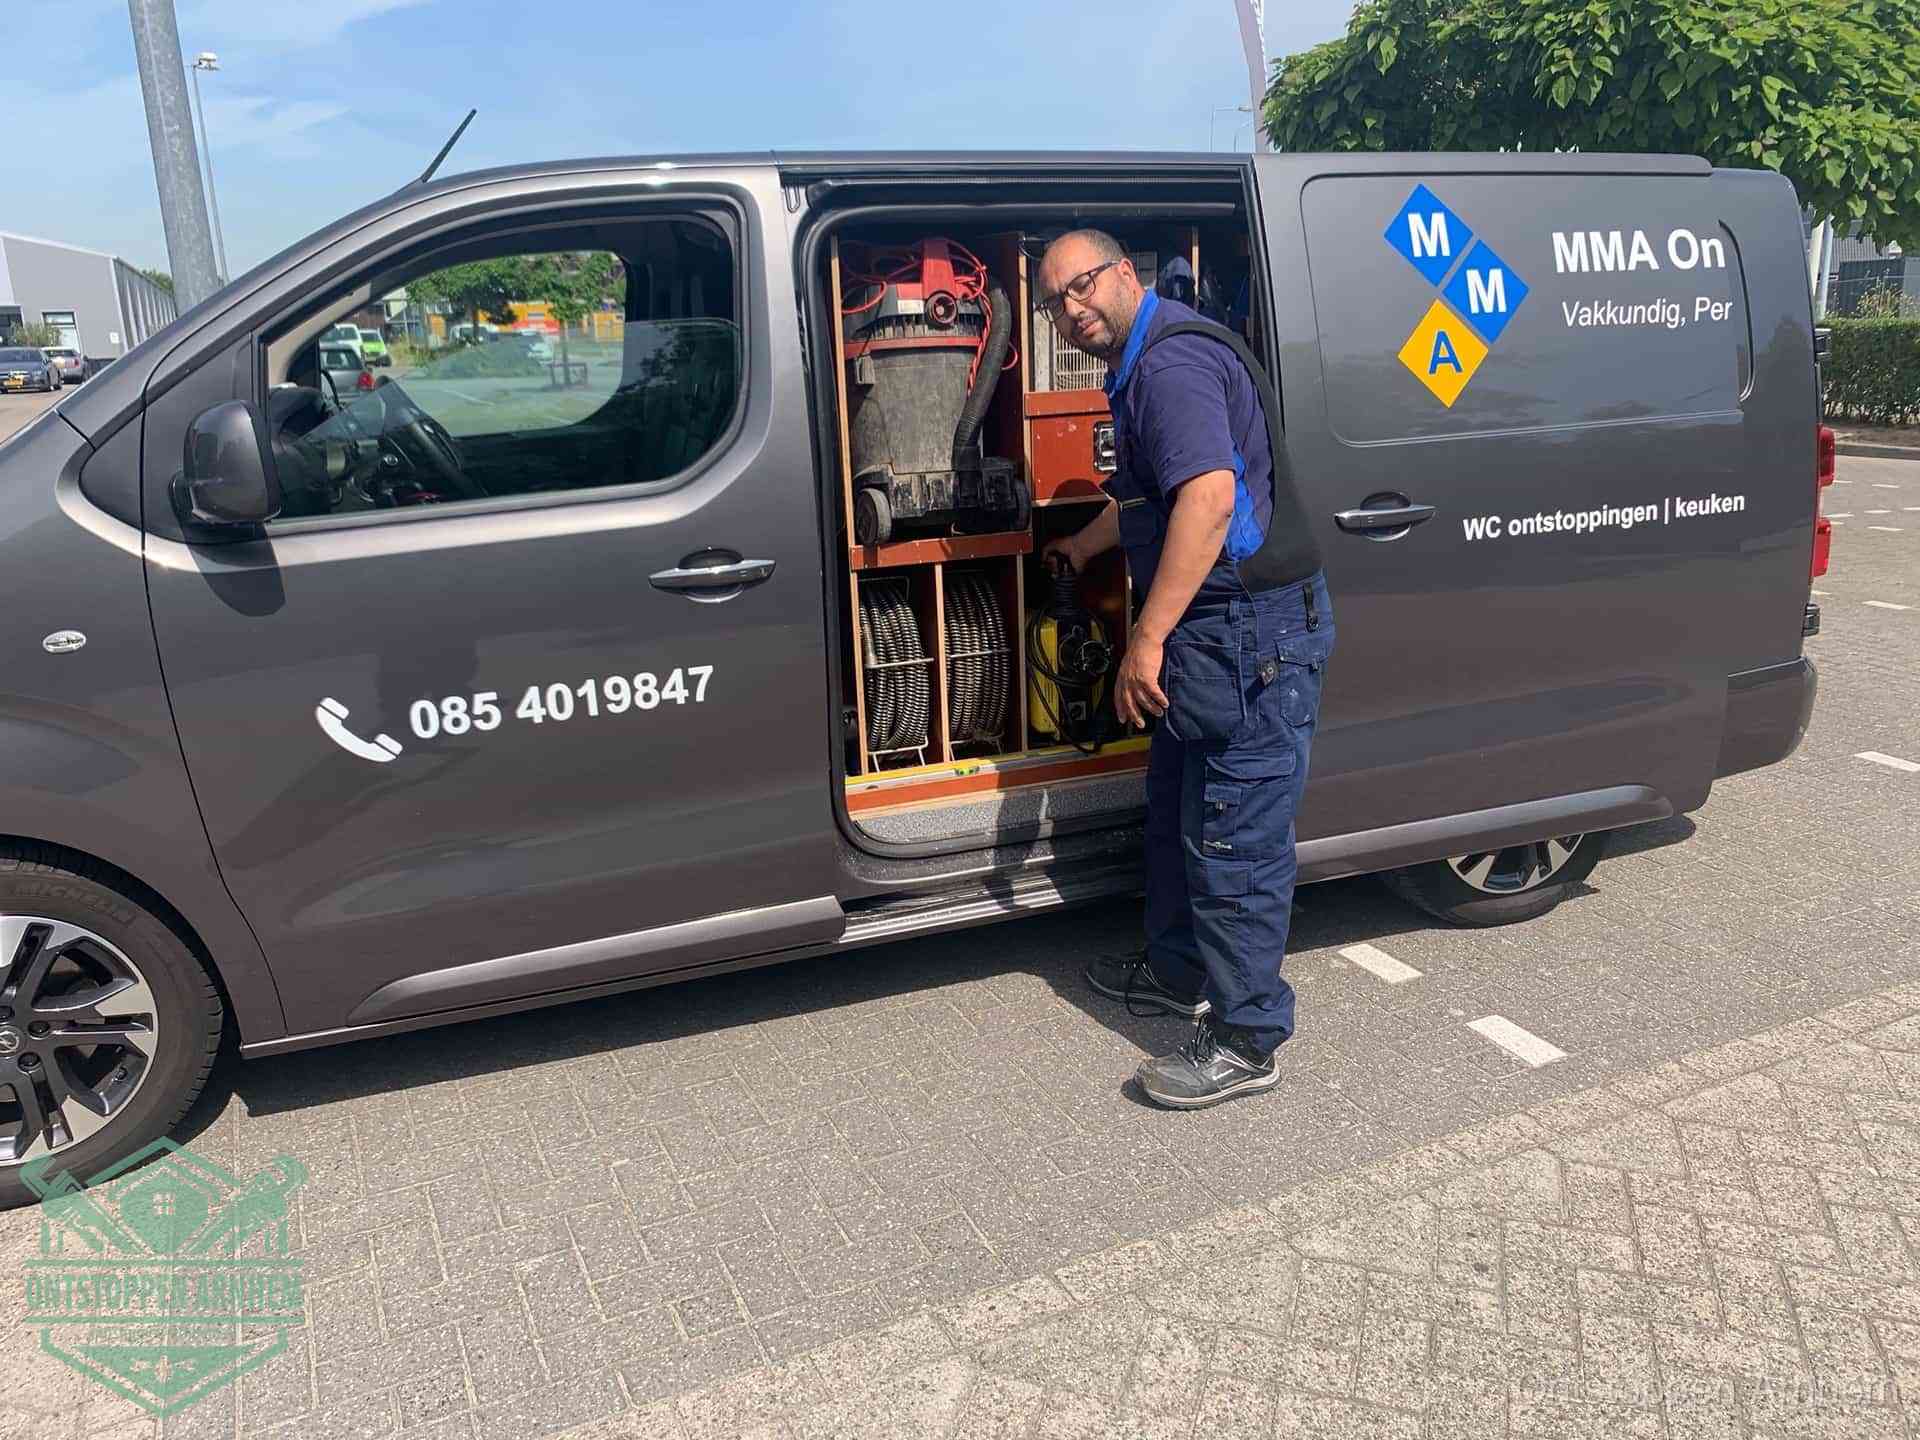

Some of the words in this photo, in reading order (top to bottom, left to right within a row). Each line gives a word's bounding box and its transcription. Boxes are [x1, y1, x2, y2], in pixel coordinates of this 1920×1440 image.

[1407, 212, 1450, 257] M
[1552, 230, 1659, 273] MMA
[1667, 229, 1725, 270] On
[1466, 268, 1507, 314] M
[1562, 299, 1688, 329] Vakkundig,
[1694, 297, 1733, 322] Per
[1428, 330, 1463, 374] A
[1463, 516, 1501, 540] WC
[1508, 504, 1659, 533] ontstoppingen
[1675, 493, 1746, 518] keuken
[409, 692, 501, 739] 085
[515, 664, 715, 724] 4019847
